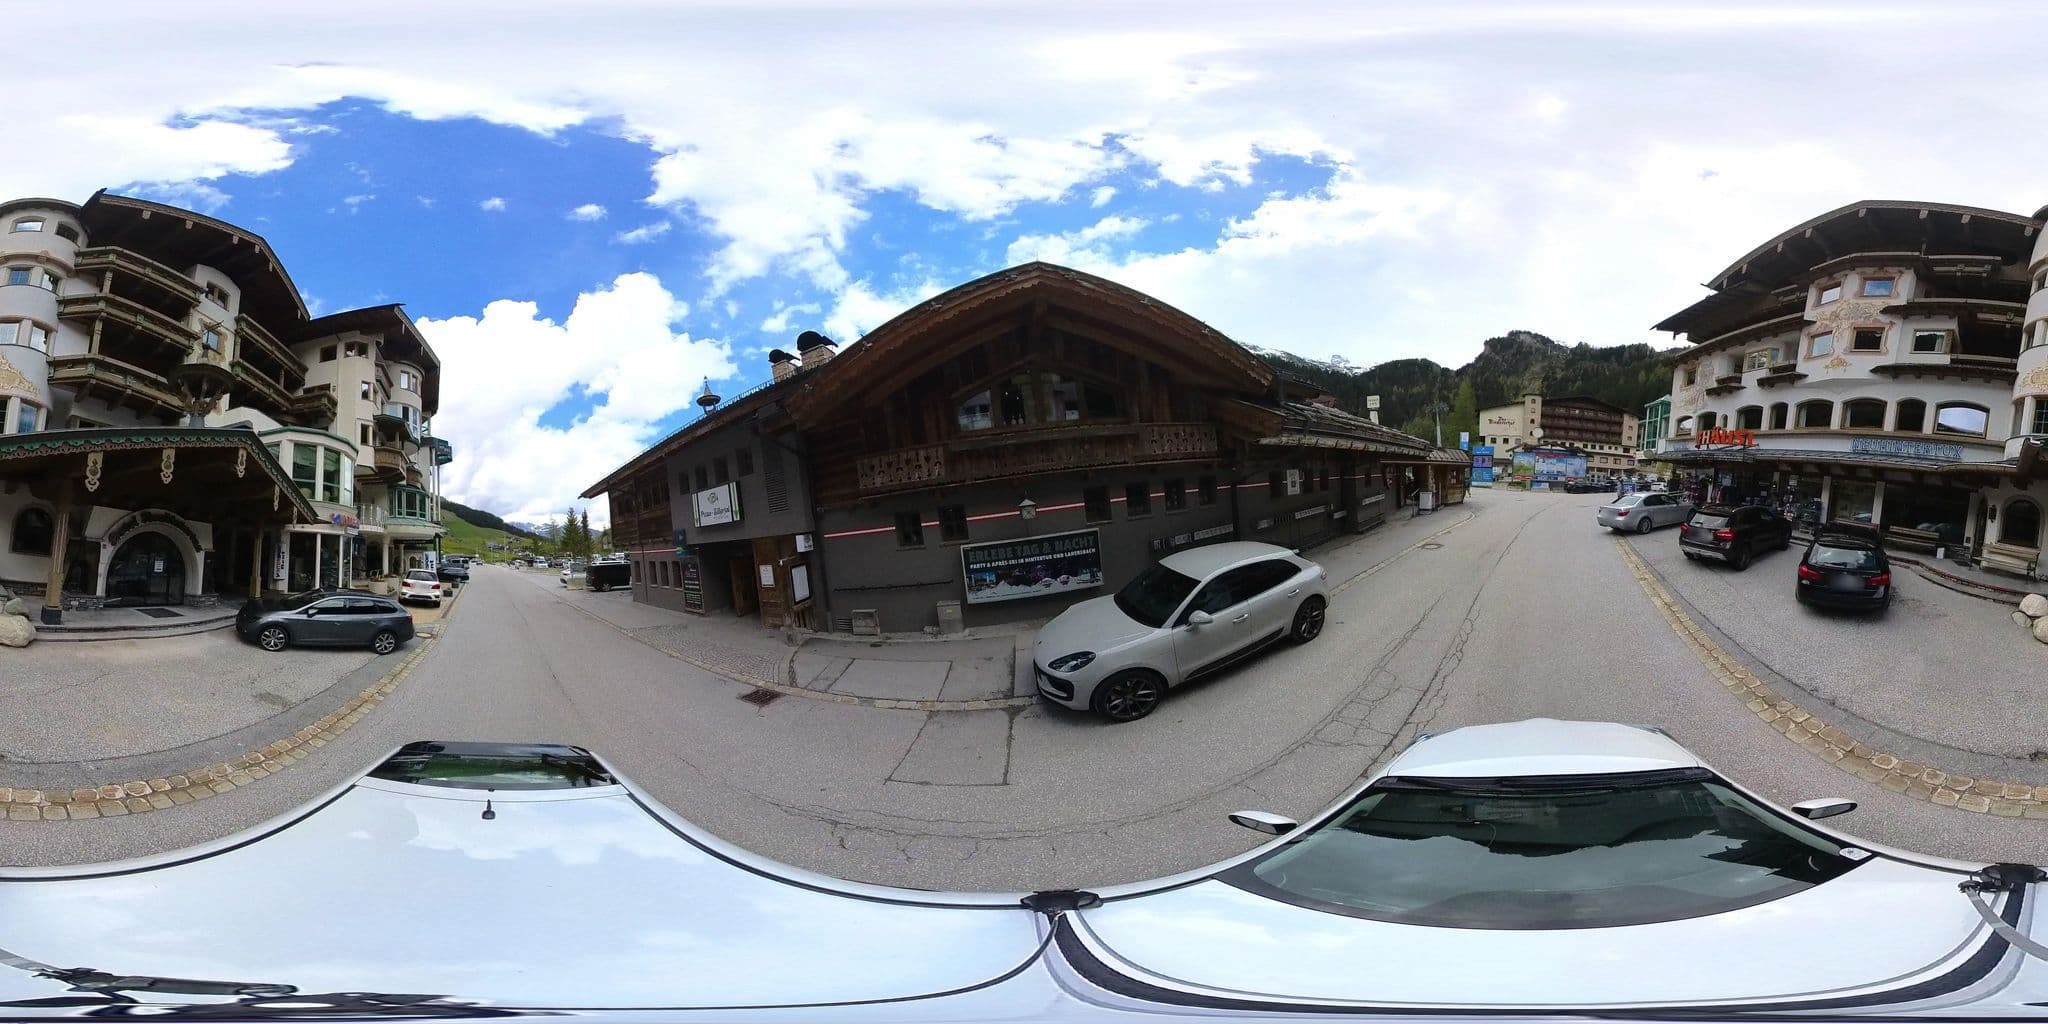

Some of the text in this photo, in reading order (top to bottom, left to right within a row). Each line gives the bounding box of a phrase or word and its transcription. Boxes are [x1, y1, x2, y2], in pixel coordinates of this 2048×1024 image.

[969, 536, 1095, 562] ERLEBE TAG & NACHT
